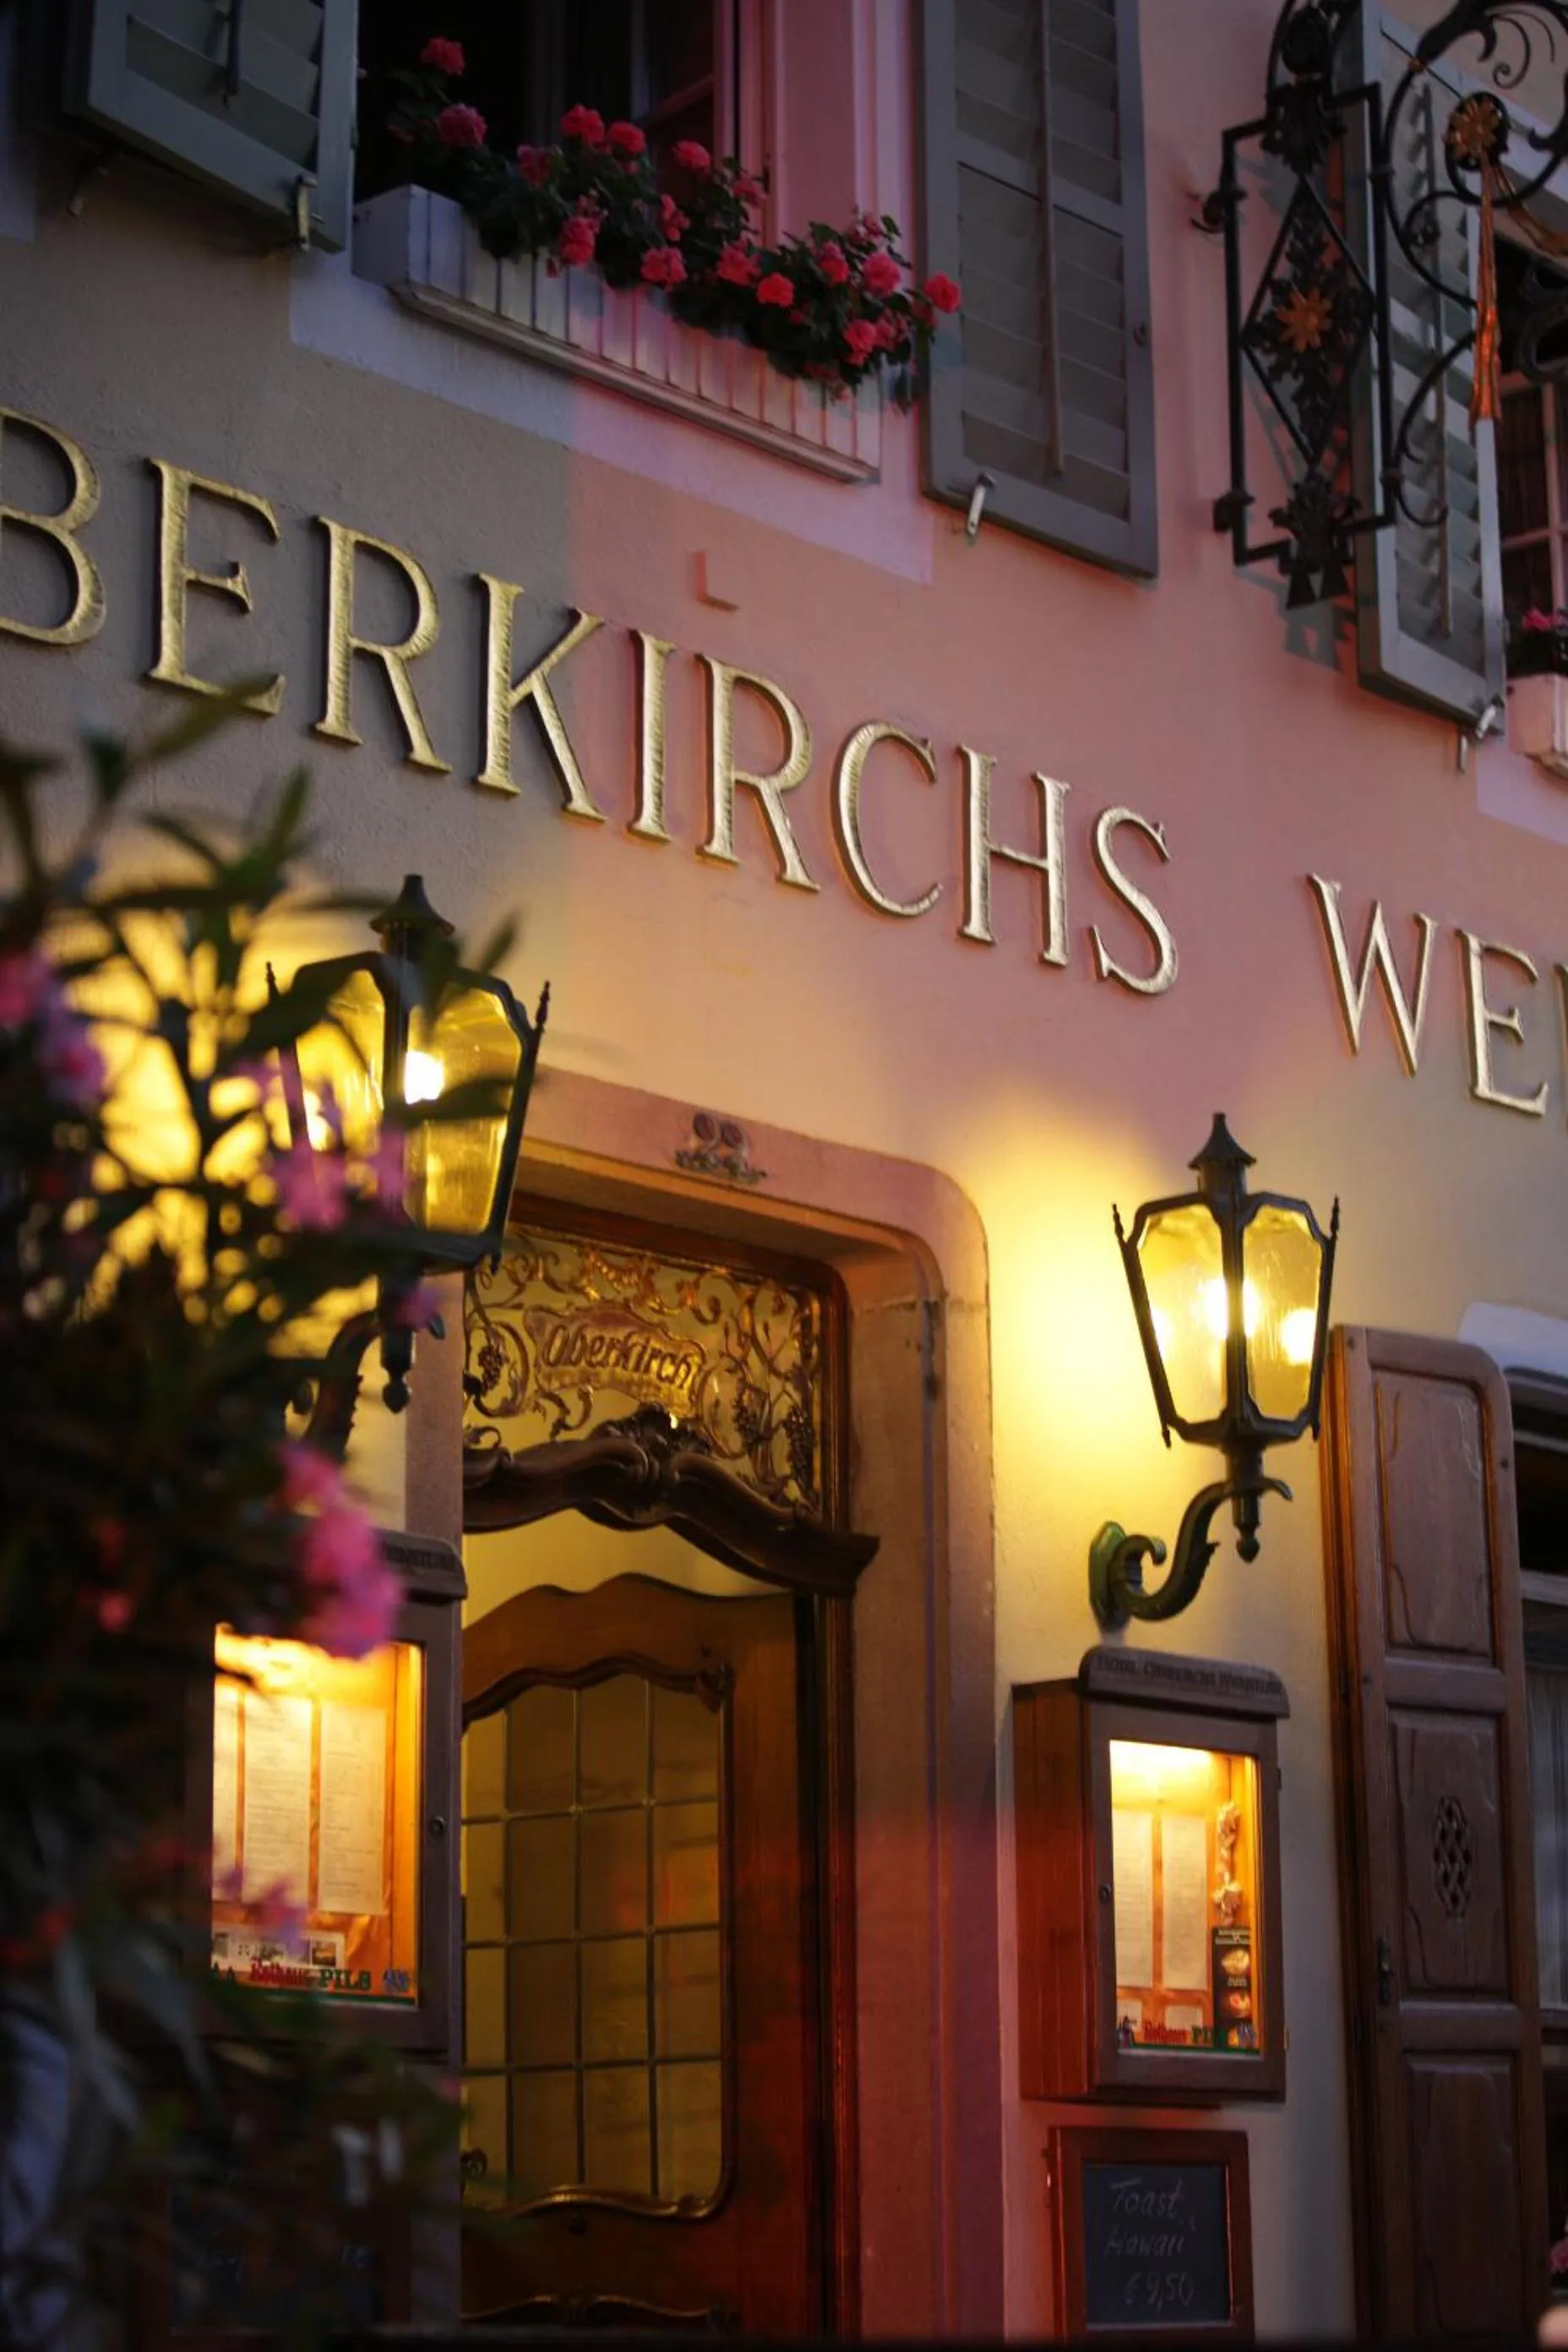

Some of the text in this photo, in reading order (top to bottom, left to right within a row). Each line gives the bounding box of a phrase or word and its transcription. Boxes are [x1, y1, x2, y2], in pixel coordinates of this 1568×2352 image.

[1306, 873, 1568, 1130] WE
[320, 1968, 371, 1990] PILS
[1108, 2176, 1184, 2219] Toast
